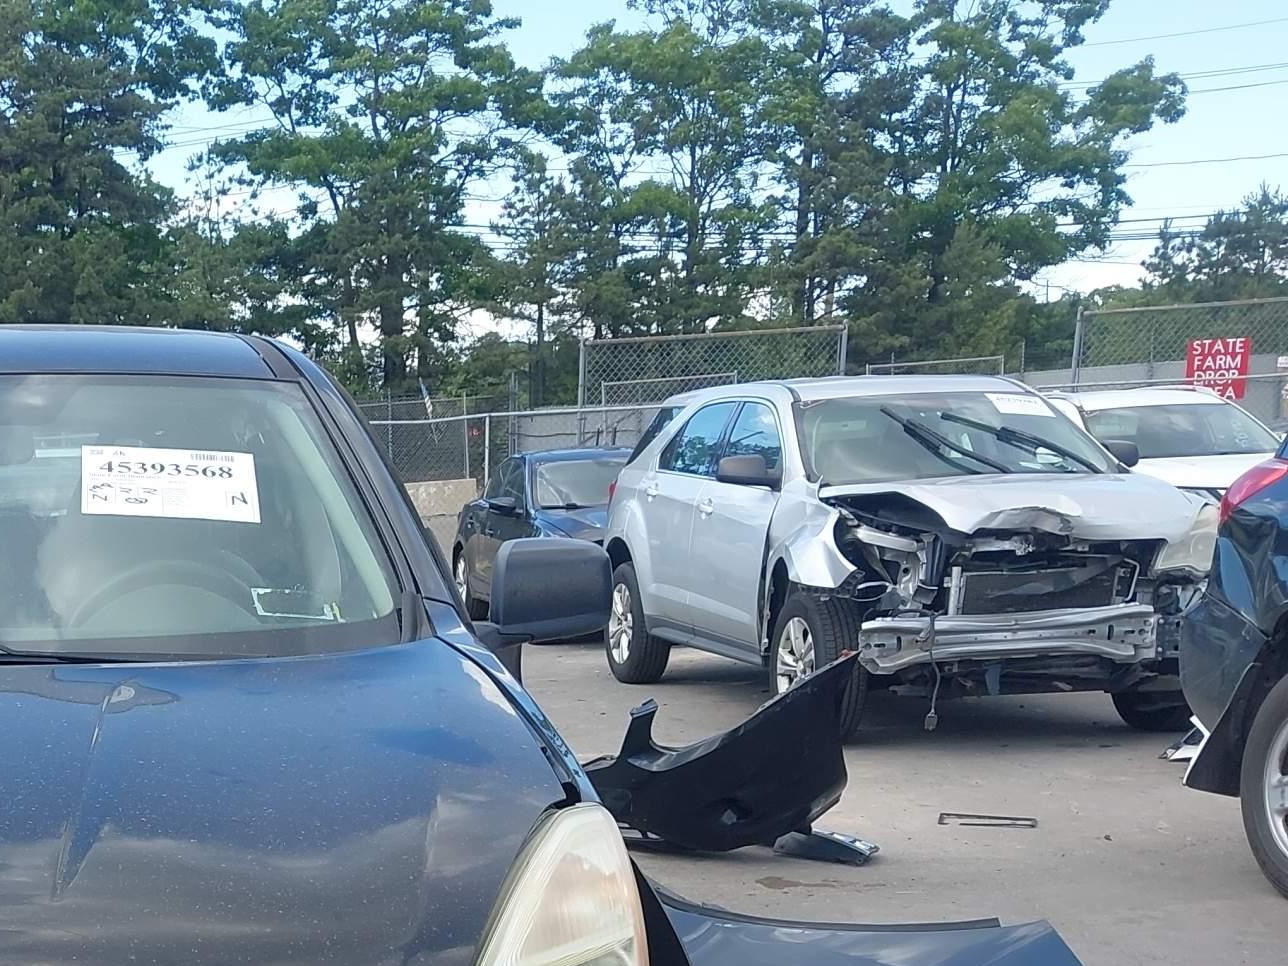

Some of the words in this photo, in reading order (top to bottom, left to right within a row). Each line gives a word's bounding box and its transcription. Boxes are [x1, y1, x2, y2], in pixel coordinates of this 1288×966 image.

[1192, 337, 1245, 355] STATE
[1193, 353, 1242, 370] FARM
[1193, 369, 1239, 385] DROP
[1214, 386, 1236, 400] EA
[98, 460, 233, 479] 45393568
